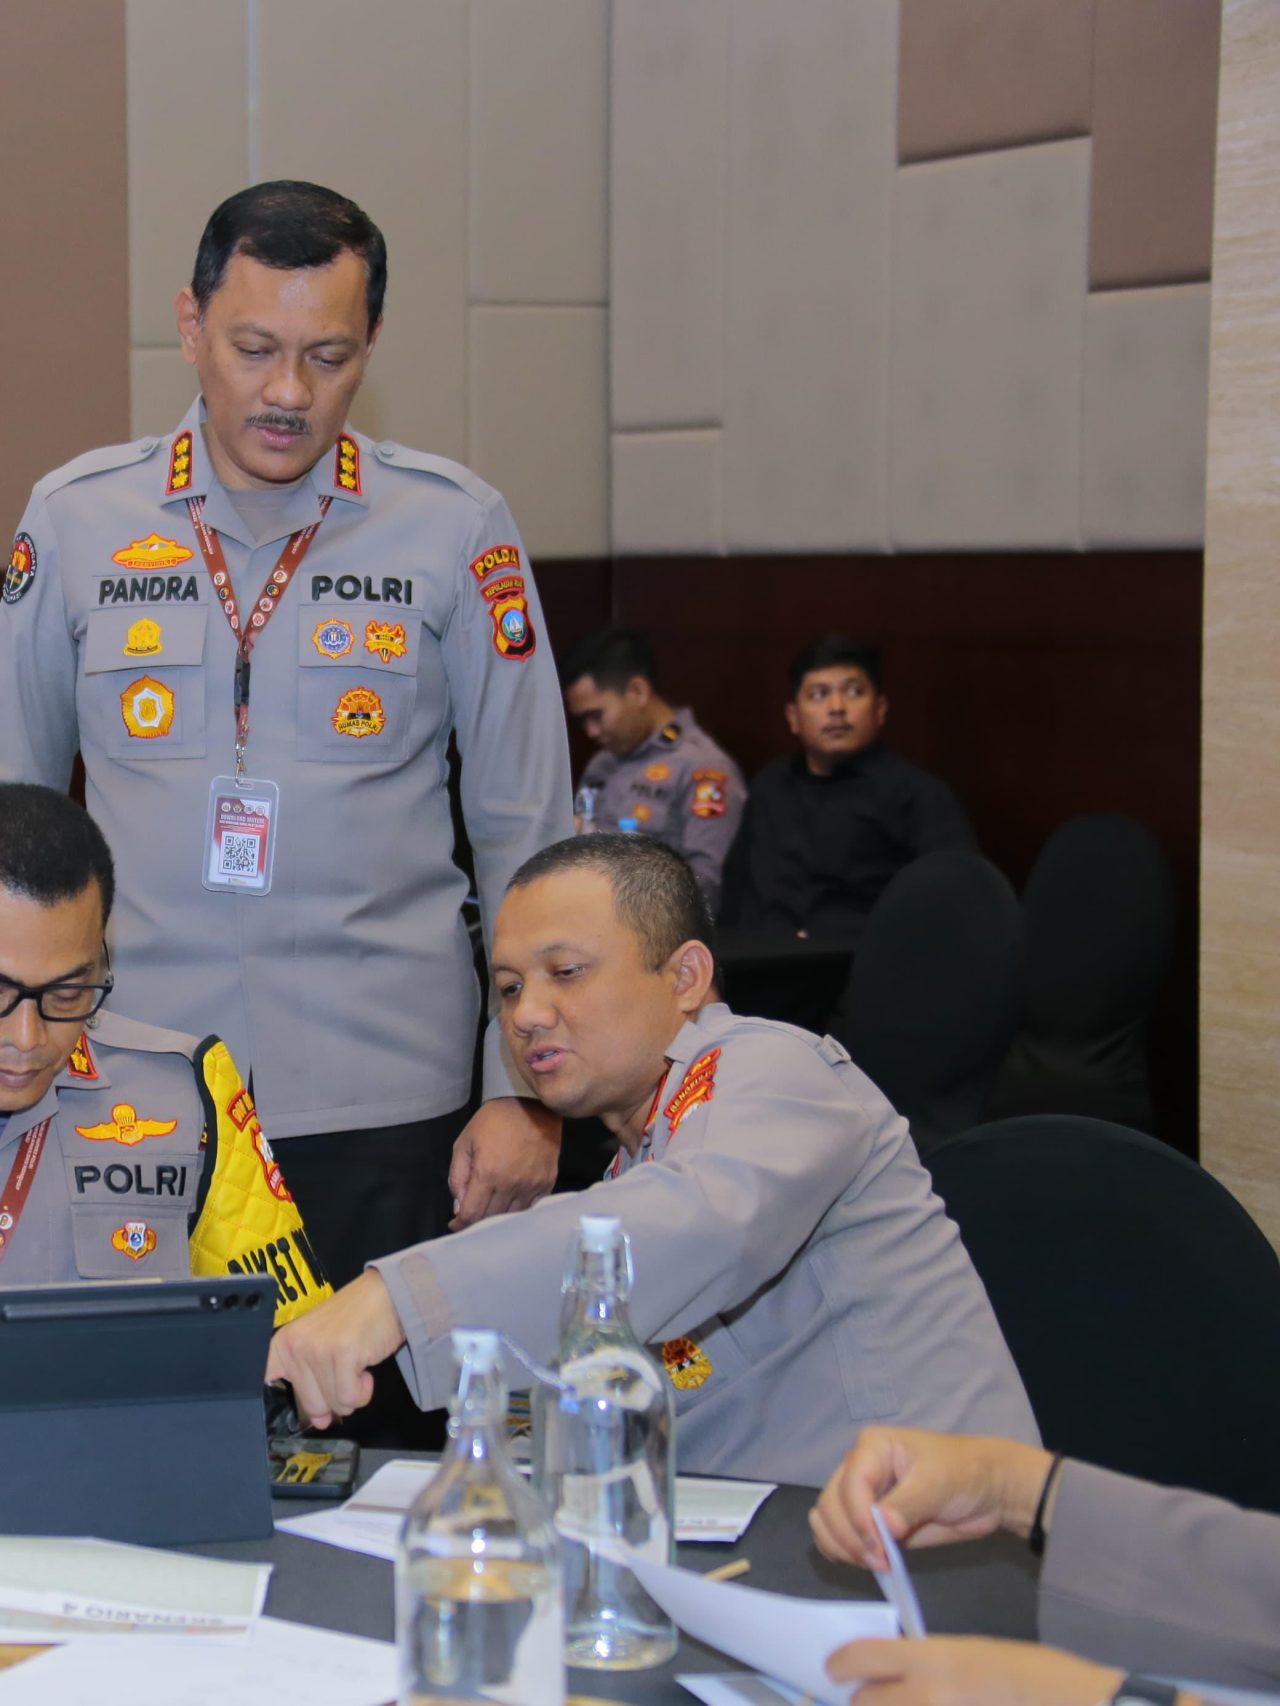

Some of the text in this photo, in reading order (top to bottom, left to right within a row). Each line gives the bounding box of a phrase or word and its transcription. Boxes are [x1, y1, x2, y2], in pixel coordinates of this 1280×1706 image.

[474, 548, 518, 577] POLDA
[98, 576, 199, 605] PANDRA
[311, 575, 413, 605] POLRI
[338, 719, 379, 731] HUMAS POLRI
[74, 1164, 187, 1196] POLRI
